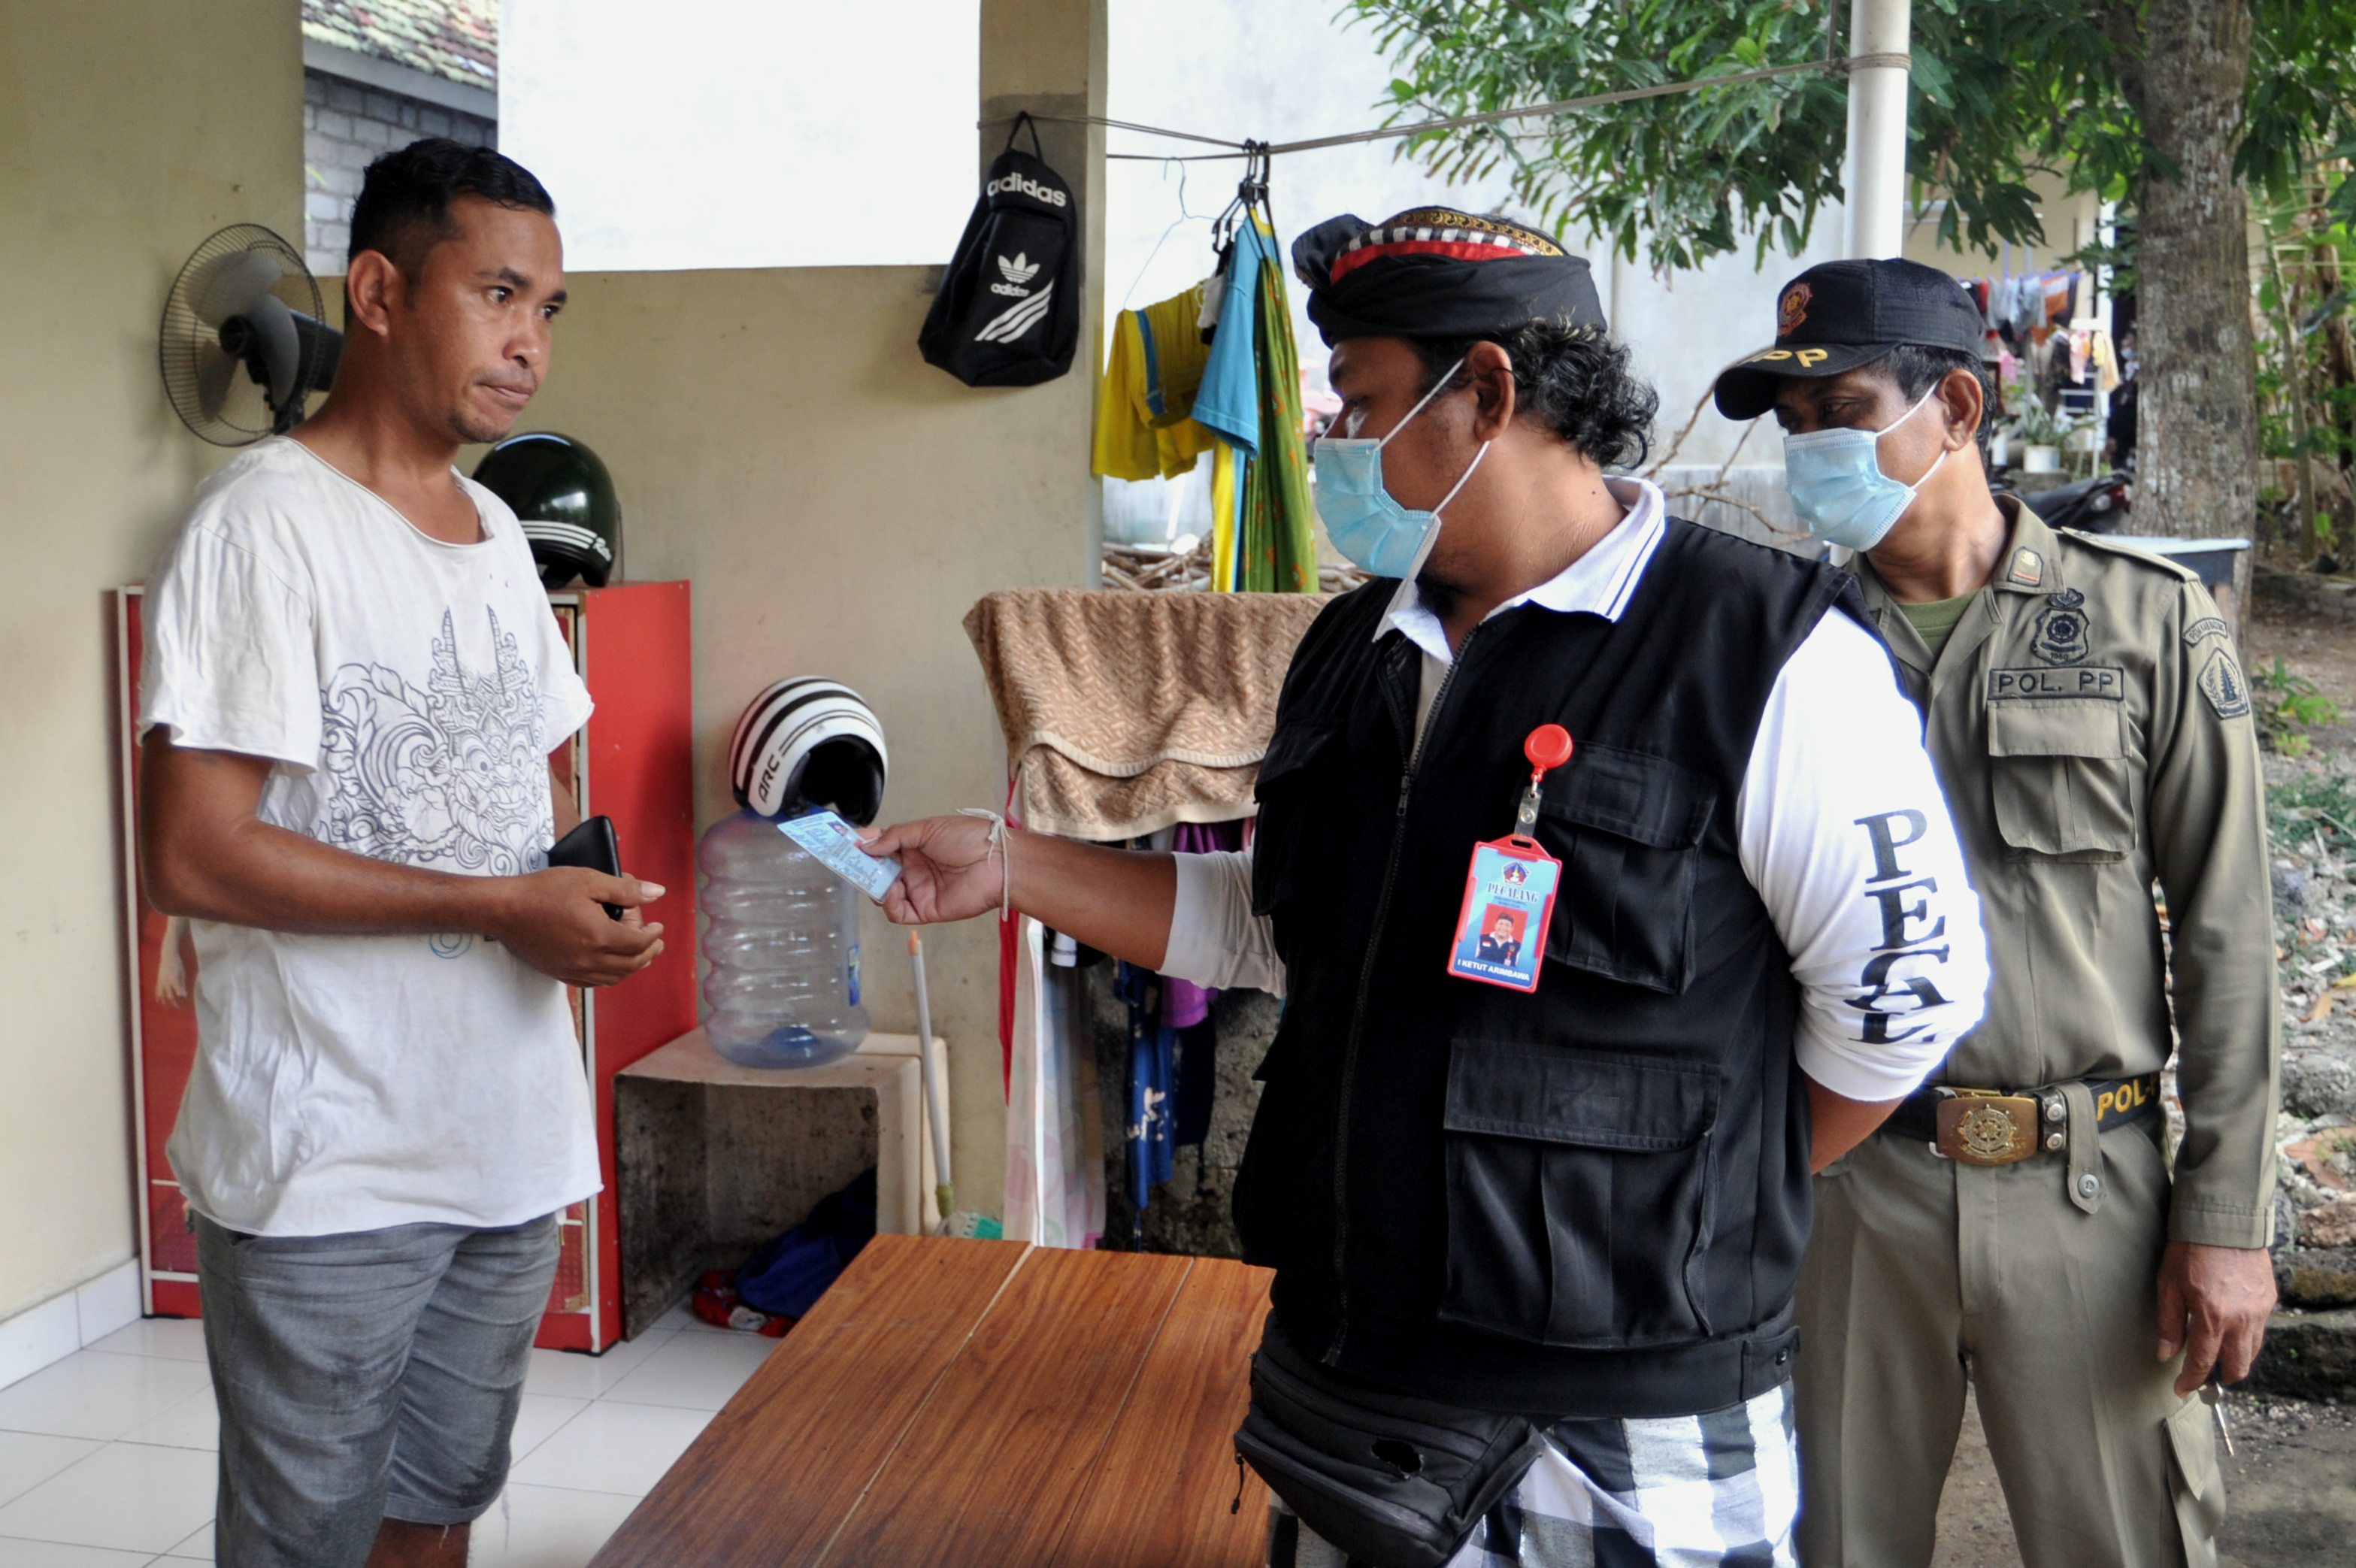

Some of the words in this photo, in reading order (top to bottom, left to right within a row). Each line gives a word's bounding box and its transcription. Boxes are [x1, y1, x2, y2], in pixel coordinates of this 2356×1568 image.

[987, 171, 1066, 207] adidas
[991, 283, 1030, 297] adidas
[1998, 673, 2062, 693] POL.
[2079, 670, 2113, 692] PP
[1488, 882, 1539, 903] PECALANG
[1461, 959, 1488, 971] KETUT
